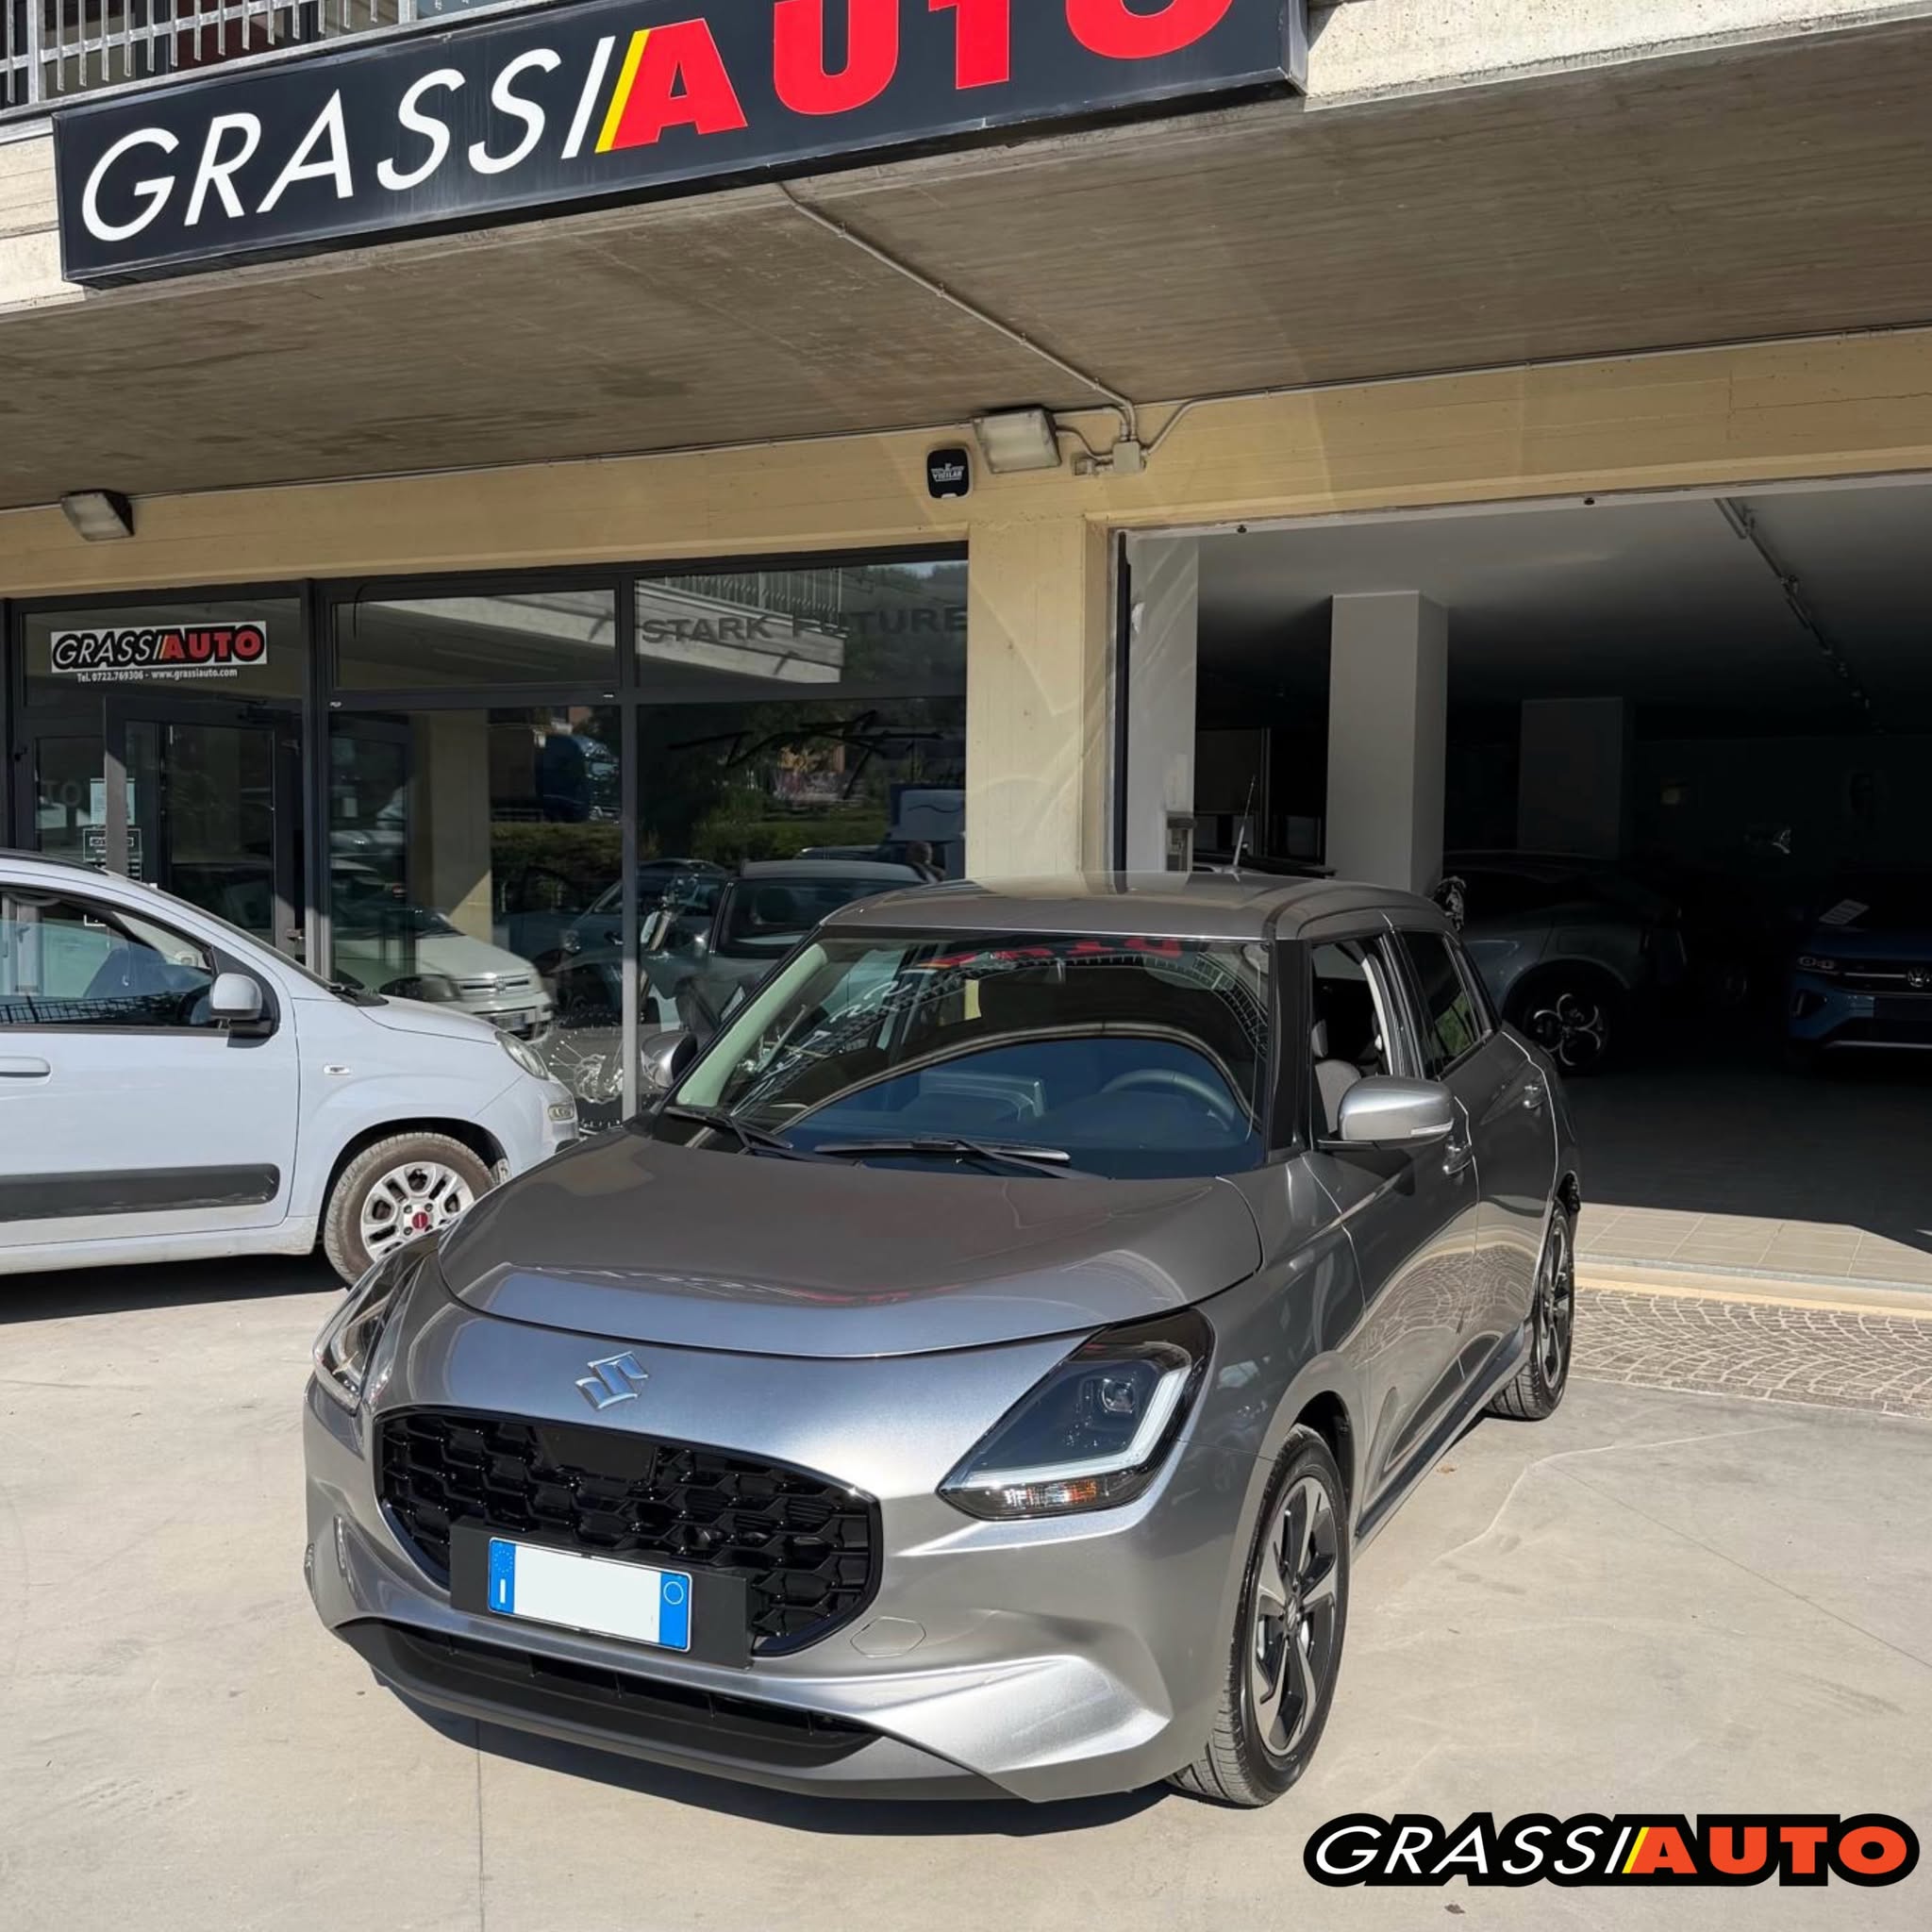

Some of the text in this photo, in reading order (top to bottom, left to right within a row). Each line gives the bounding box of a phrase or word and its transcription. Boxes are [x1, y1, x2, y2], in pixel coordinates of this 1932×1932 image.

[641, 615, 774, 643] STARK
[76, 672, 91, 683] Tel.
[92, 671, 143, 682] 0722.769306
[151, 668, 238, 681] www.grassiauto.com
